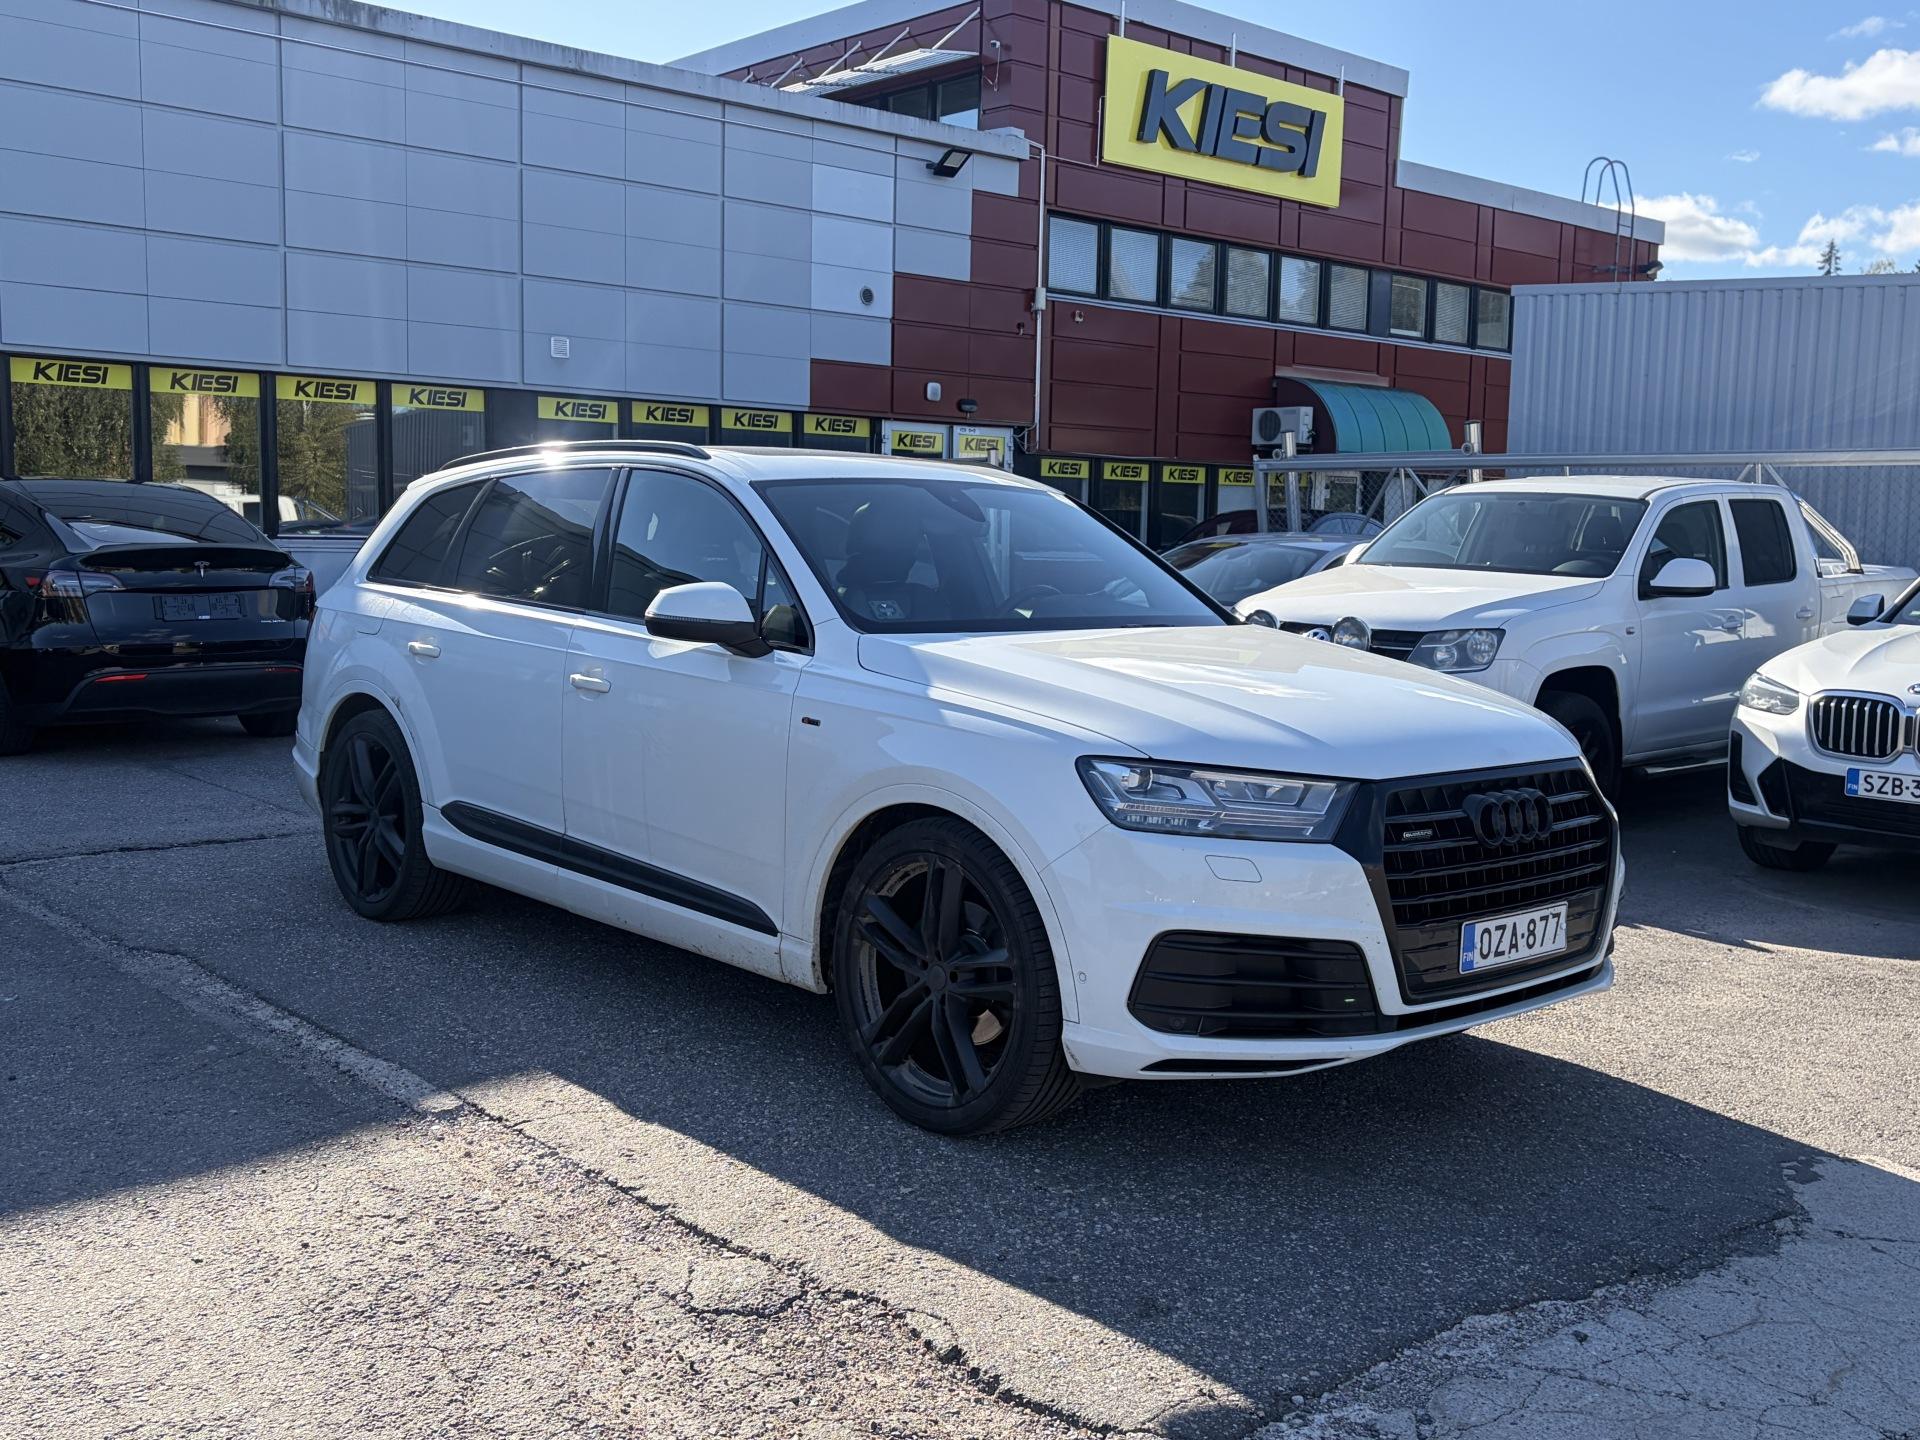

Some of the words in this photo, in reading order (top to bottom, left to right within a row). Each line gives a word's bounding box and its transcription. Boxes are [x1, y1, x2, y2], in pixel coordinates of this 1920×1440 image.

[1137, 69, 1327, 178] KIESI
[33, 362, 109, 385] KIESI
[170, 372, 239, 393] KIESI
[294, 380, 357, 401] KIESI
[408, 387, 467, 408] KIESI
[554, 401, 607, 420] KIESI
[646, 405, 694, 424] KIESI
[733, 412, 778, 429] KIESI
[815, 417, 857, 433] KIESI
[897, 433, 937, 449] KIESI
[964, 437, 999, 451] KIESI
[1047, 461, 1081, 476] KIESI
[1110, 464, 1142, 479] KIESI
[1168, 467, 1199, 481] KIESI
[1224, 471, 1253, 484] KIESI
[1480, 911, 1562, 960] OZA-877
[1463, 951, 1474, 963] FIN
